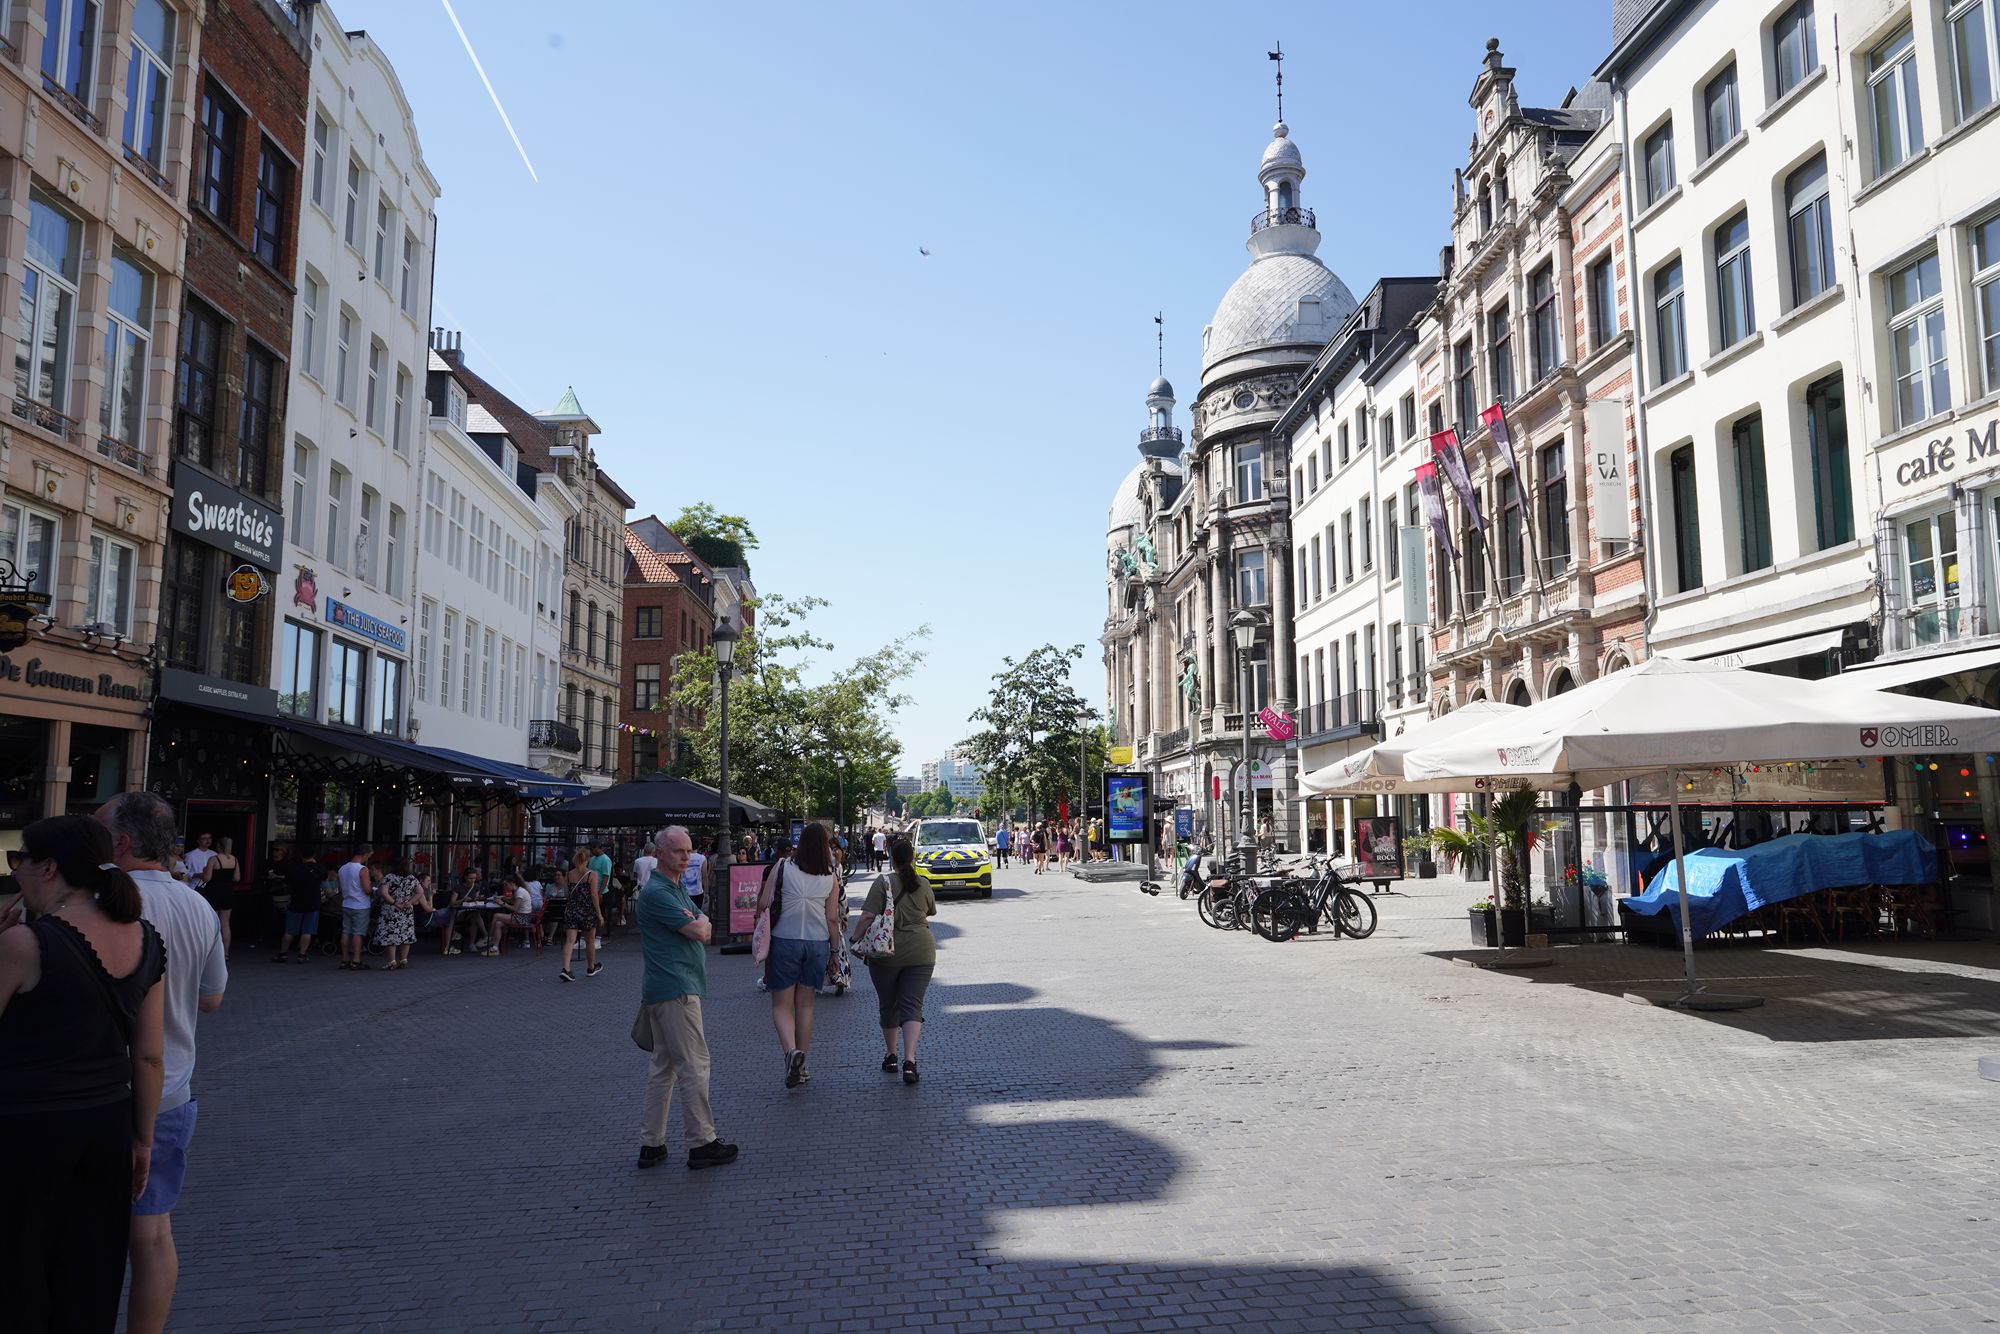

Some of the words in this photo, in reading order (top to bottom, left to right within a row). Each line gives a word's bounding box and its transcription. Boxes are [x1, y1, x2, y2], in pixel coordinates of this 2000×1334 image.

[1598, 467, 1619, 480] VA
[1896, 436, 1955, 487] café
[188, 491, 273, 548] Sweetsie's
[234, 541, 252, 555] BELGIAN
[252, 548, 270, 562] WAFFLES
[346, 610, 360, 627] THE
[360, 617, 377, 635] JUICY
[378, 624, 404, 646] SEAFOOD
[1264, 709, 1291, 735] WALLS
